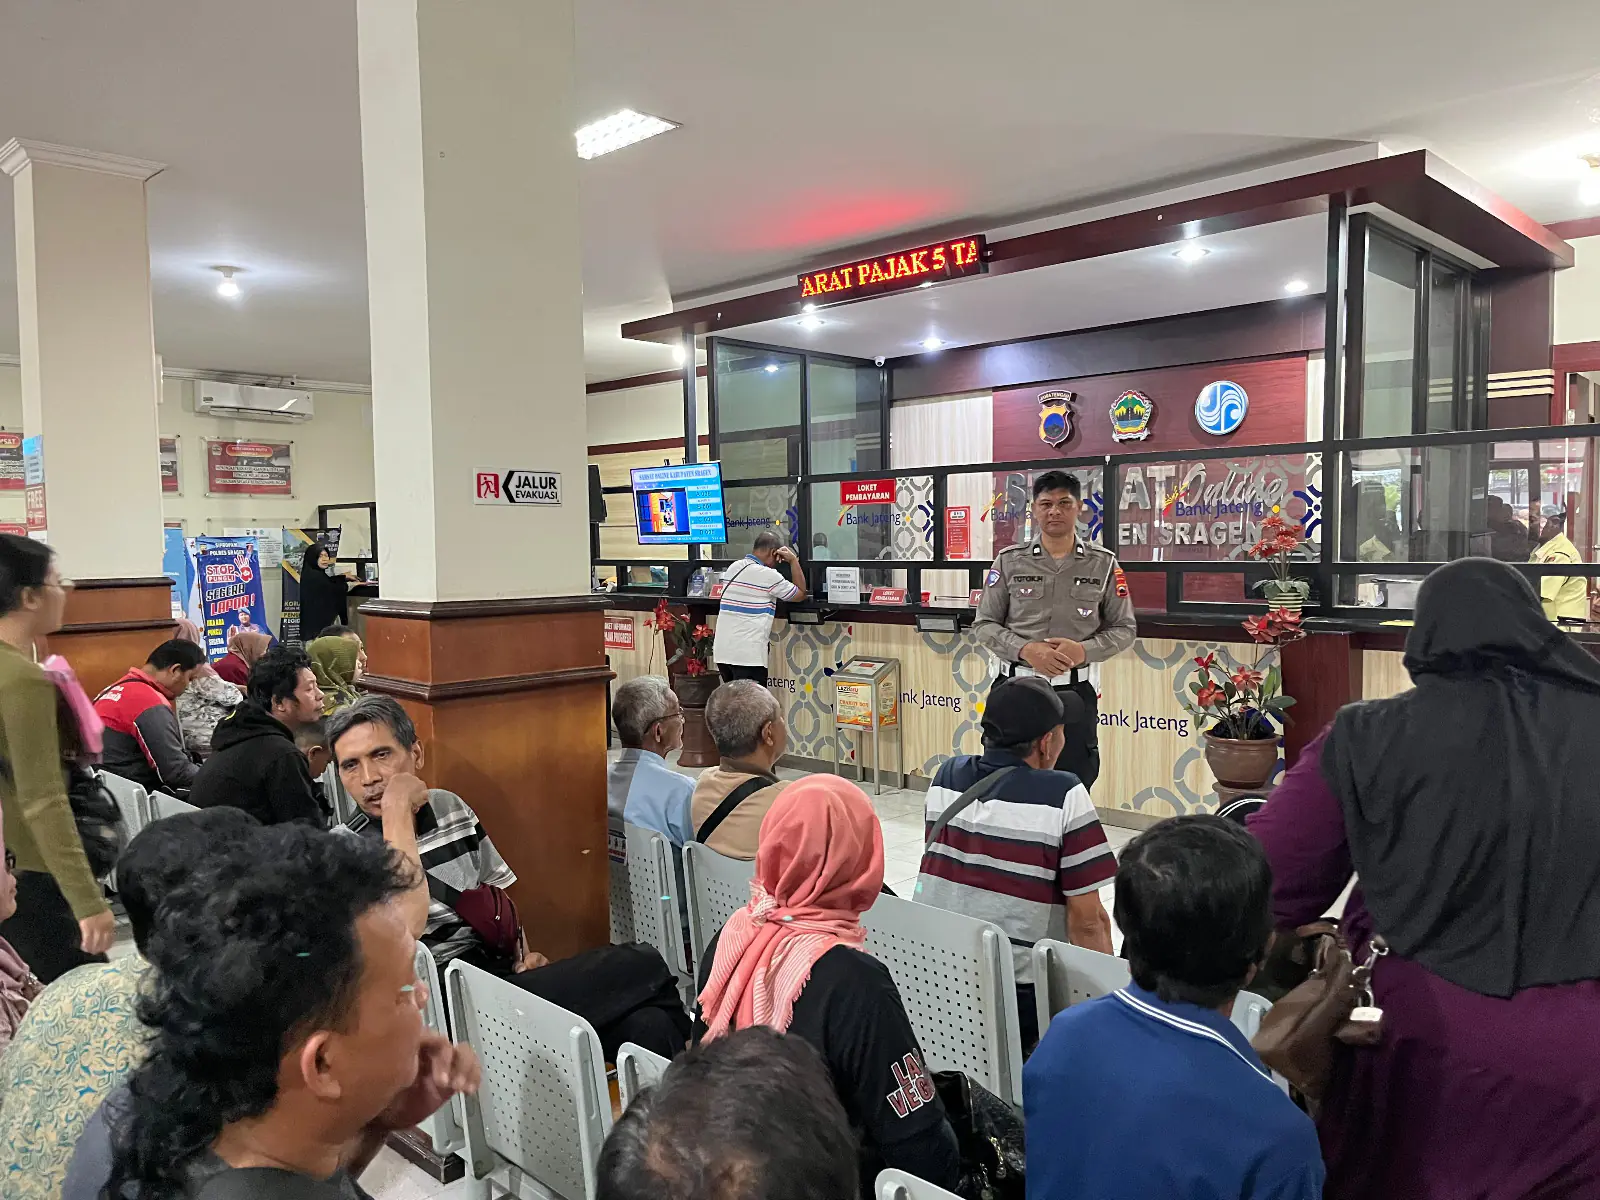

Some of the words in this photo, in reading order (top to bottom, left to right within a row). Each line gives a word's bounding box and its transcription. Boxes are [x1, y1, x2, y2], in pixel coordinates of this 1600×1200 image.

[802, 268, 853, 297] ARAT
[857, 250, 929, 286] PAJAK
[931, 247, 946, 270] 5
[515, 475, 557, 489] JALUR
[857, 483, 877, 492] LOKET
[515, 490, 558, 500] EVAKUASI
[845, 491, 890, 502] PEMBAYARAN
[991, 507, 1019, 521] Bank
[1176, 500, 1211, 517] Bank
[1213, 500, 1264, 519] Jateng
[846, 513, 868, 525] Bank
[870, 512, 901, 527] Jateng
[1160, 521, 1264, 546] SRAGEN
[206, 564, 235, 575] STOP
[207, 575, 235, 583] PUNGLI
[206, 583, 245, 601] SEGERA
[767, 676, 796, 693] ateng
[920, 690, 962, 712] Jateng
[1132, 710, 1188, 737] Jateng
[886, 1076, 936, 1118] VEG
